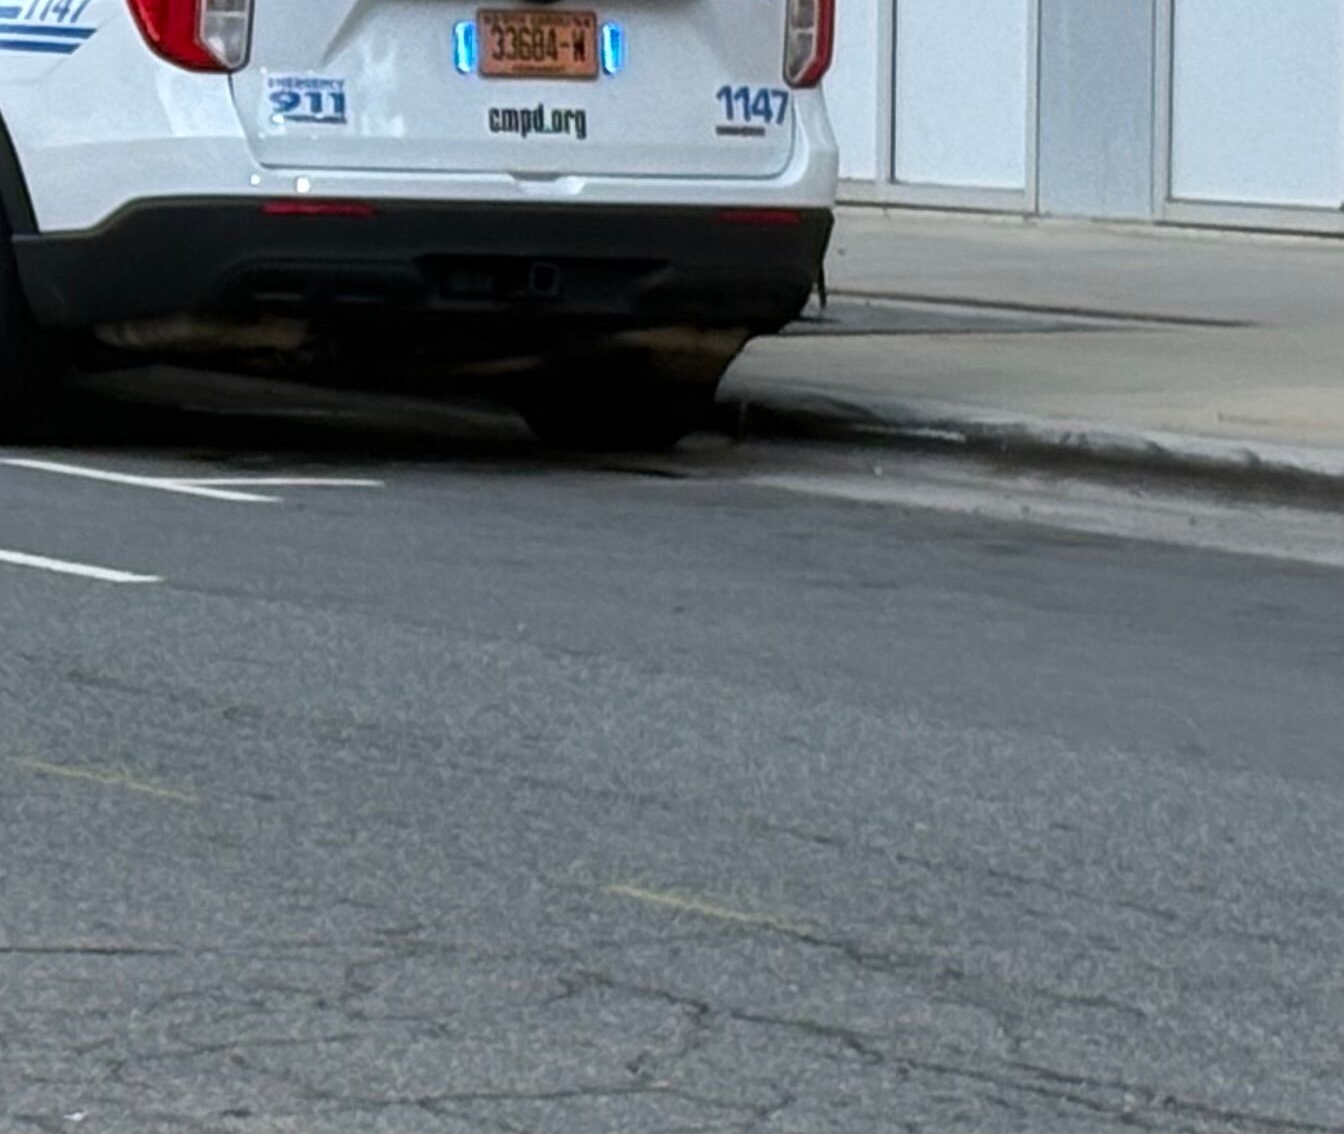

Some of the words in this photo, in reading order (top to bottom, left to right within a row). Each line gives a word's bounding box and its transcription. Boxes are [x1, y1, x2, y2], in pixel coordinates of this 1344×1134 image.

[491, 25, 587, 62] 33684-W
[268, 90, 345, 114] 911
[715, 85, 790, 126] 1147
[488, 102, 588, 140] cmpd.org
